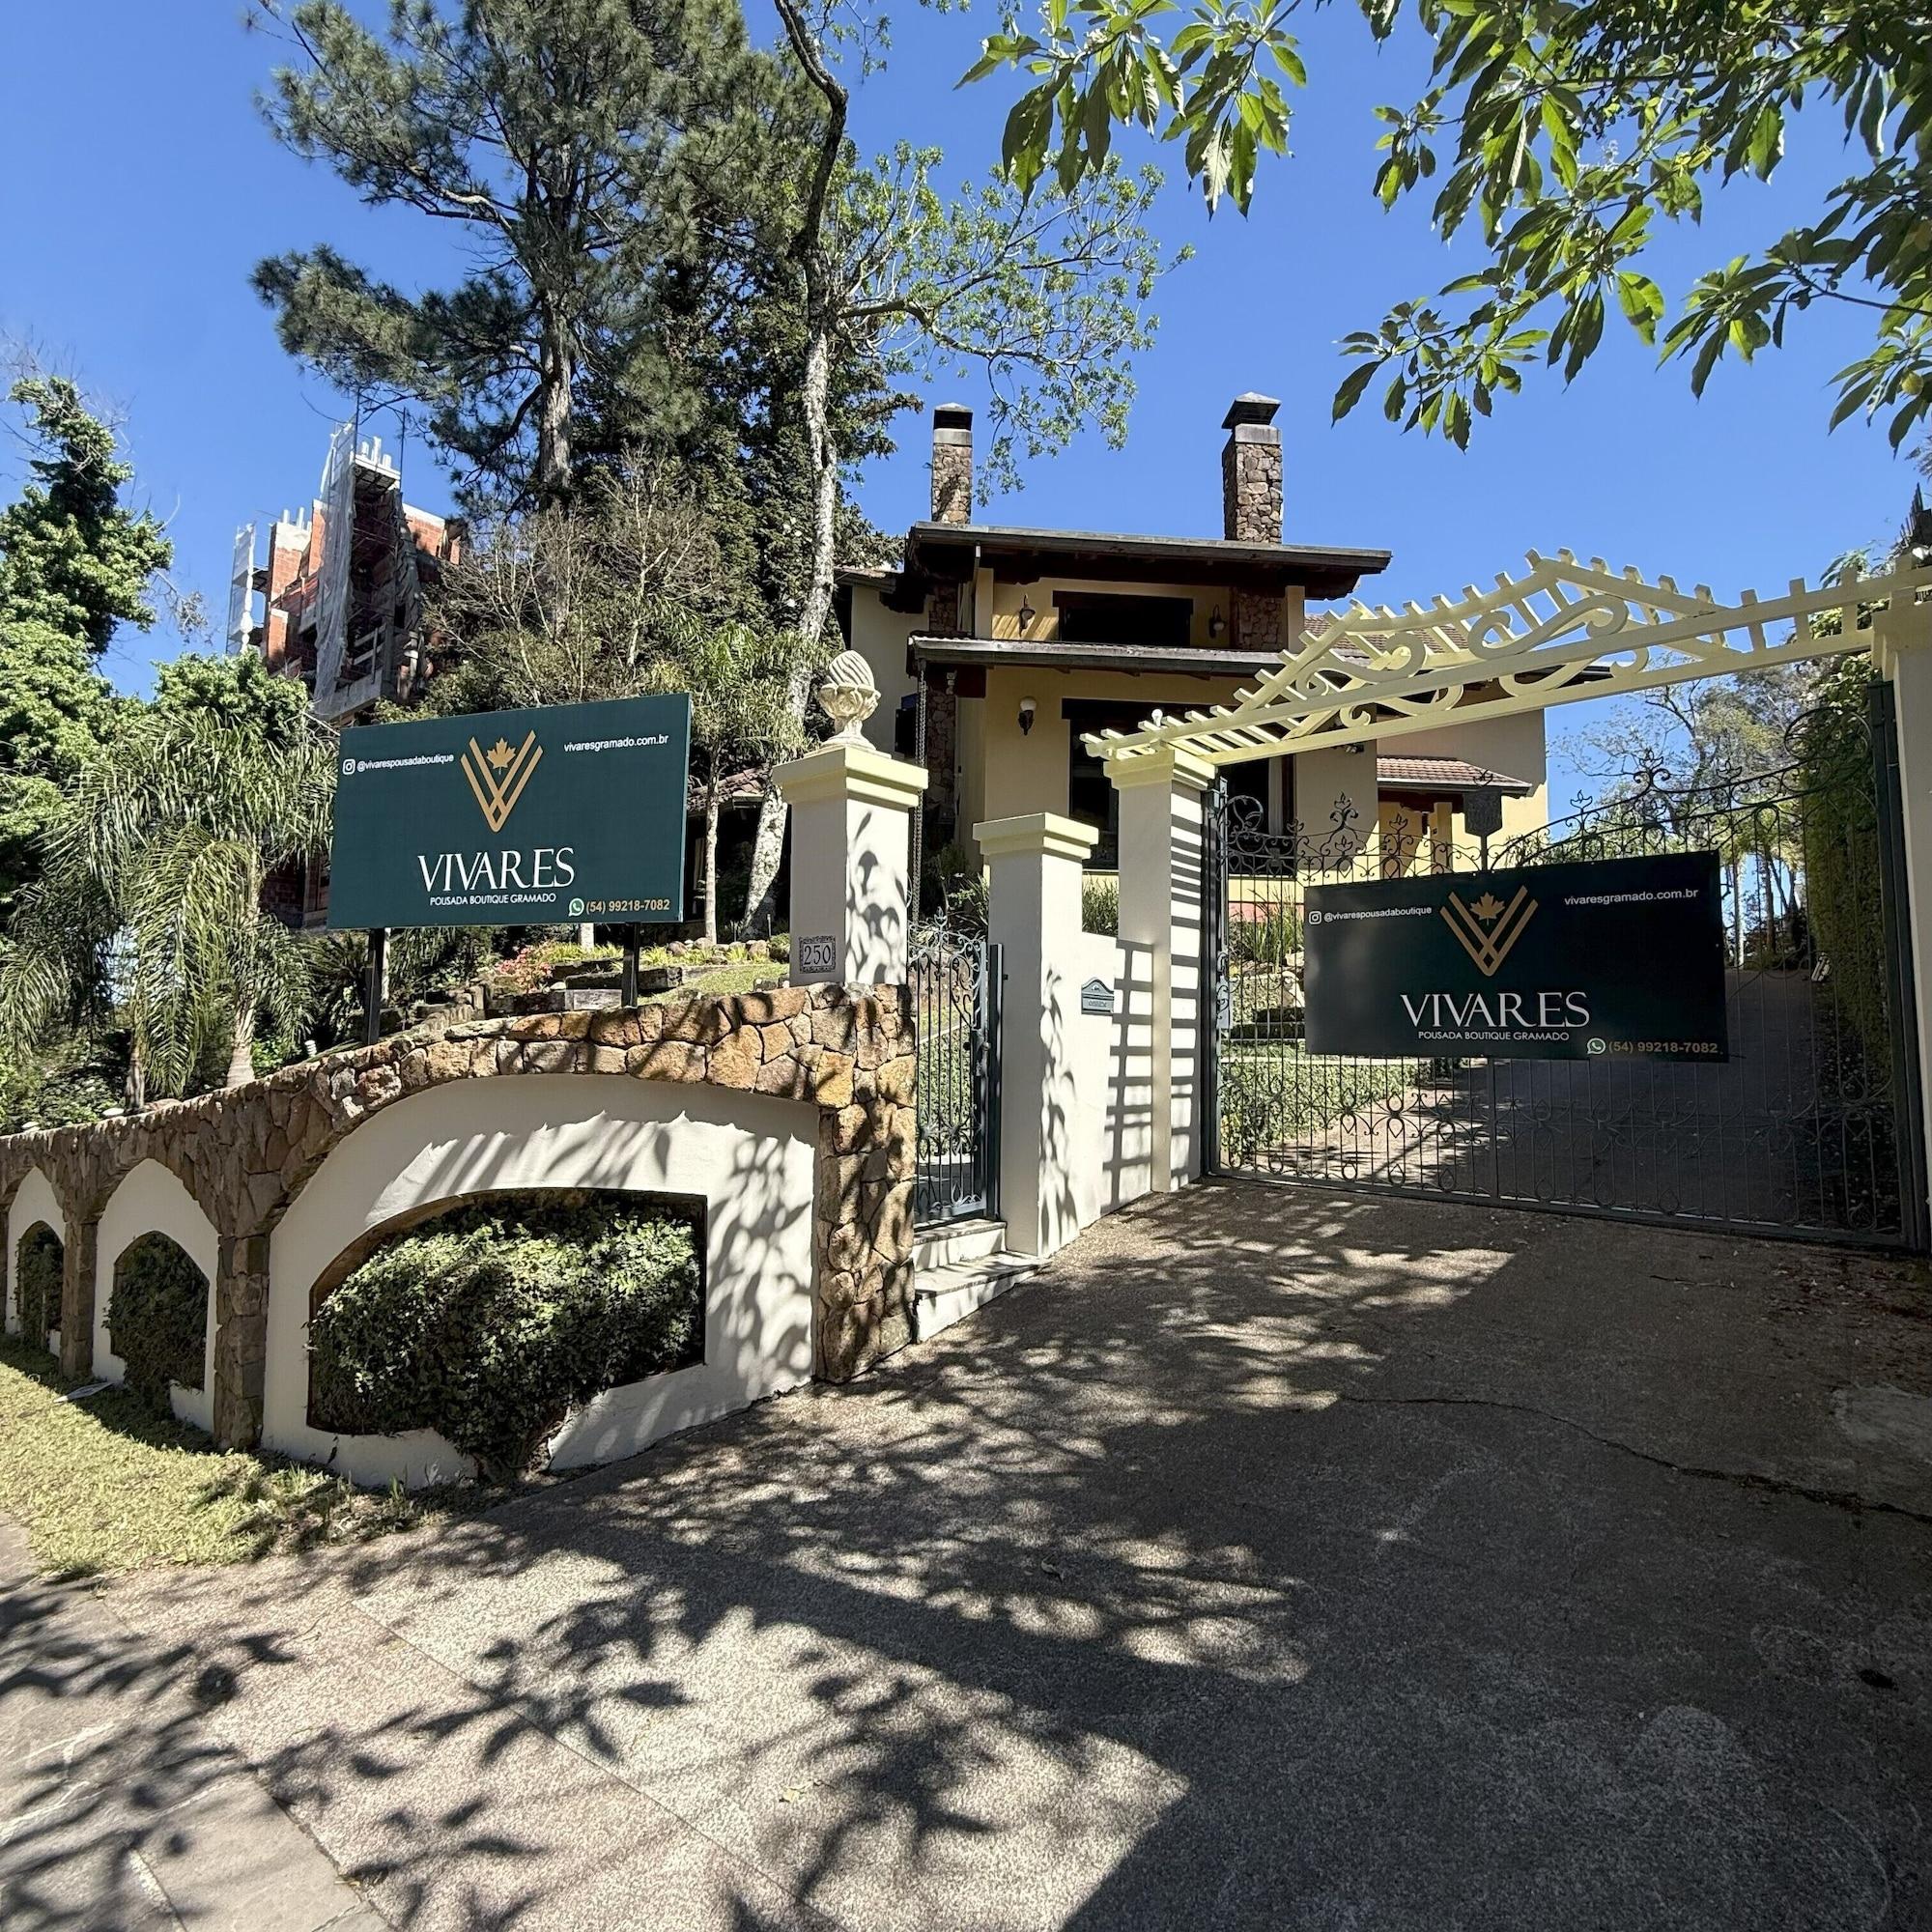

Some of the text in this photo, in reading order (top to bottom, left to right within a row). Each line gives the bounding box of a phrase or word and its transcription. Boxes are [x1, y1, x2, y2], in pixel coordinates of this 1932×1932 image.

[563, 734, 668, 752] vivaresgramado.com.br
[356, 753, 454, 772] @vivarespousadaboutique
[417, 846, 576, 893] VIVARES
[430, 893, 556, 906] POUSADA BOUTIQUE GRAMADO
[1564, 888, 1699, 906] vivaresgramado.com.br
[585, 898, 670, 915] (54) 99218-7082
[1323, 905, 1433, 923] @vivarespousadaboutique
[804, 945, 832, 965] 250
[1400, 991, 1590, 1029] VIVARES
[1418, 1031, 1570, 1041] POUSADA BOUTIQUE GRAMADO
[1608, 1040, 1719, 1055] (54) 99218-7082
